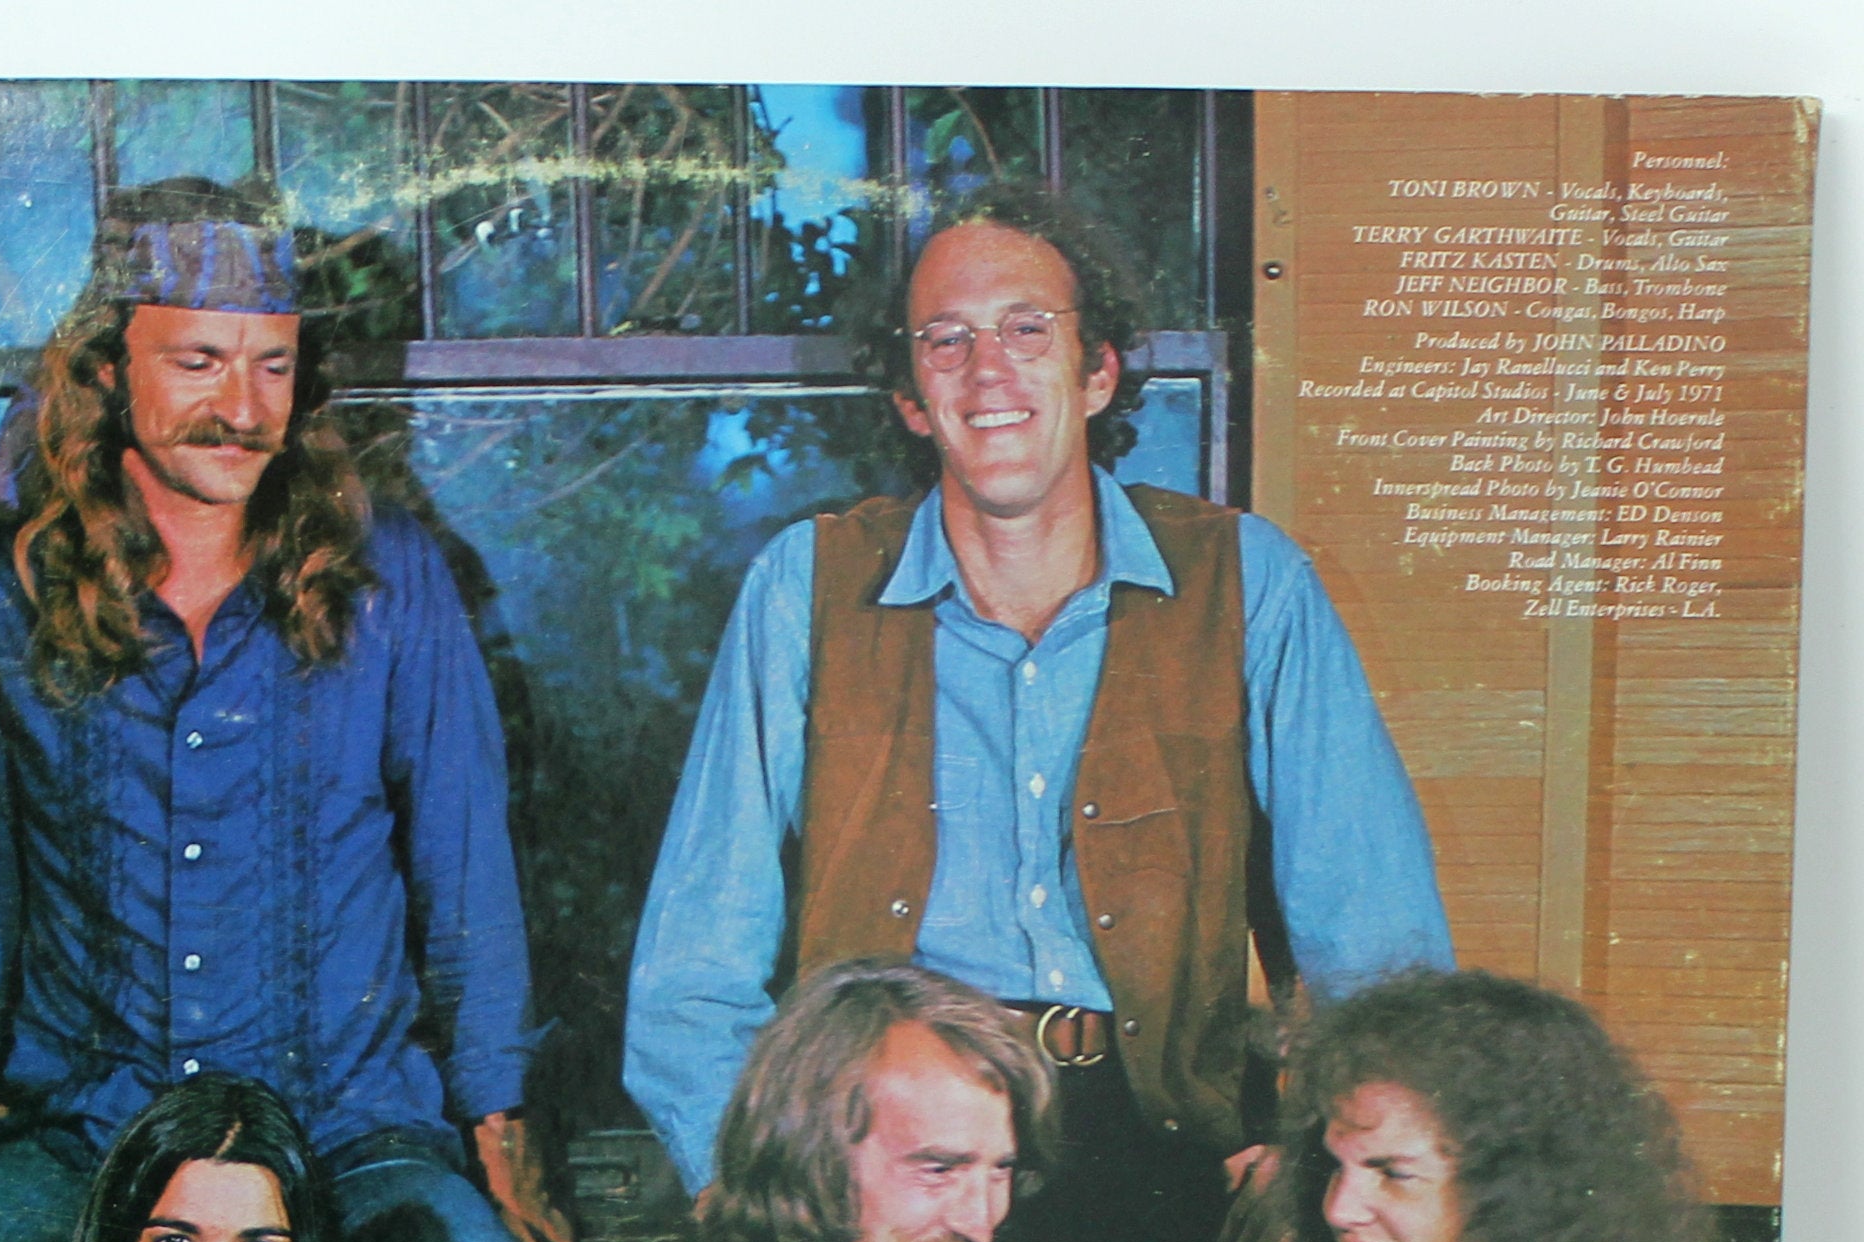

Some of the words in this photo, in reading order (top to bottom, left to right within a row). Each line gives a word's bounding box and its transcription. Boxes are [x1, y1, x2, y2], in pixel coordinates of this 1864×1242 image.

[1633, 151, 1729, 171] Personnel:
[1388, 180, 1447, 197] TONI
[1453, 181, 1542, 198] BROWN
[1562, 183, 1623, 203] Vocals,
[1628, 182, 1728, 205] Keyboards,
[1353, 226, 1426, 244] TERRY
[1434, 227, 1582, 246] GARTHWAITE
[1603, 230, 1662, 249] Vocals,
[1670, 231, 1728, 247] Guitar
[1396, 276, 1443, 295] JEFF
[1449, 277, 1567, 295] NEIGHBOR
[1585, 278, 1628, 297] Bass,
[1635, 279, 1728, 296] Trombone
[1364, 300, 1412, 318] RON
[1422, 301, 1507, 318] WILSON
[1526, 303, 1596, 324] Congas,
[1602, 303, 1674, 325] Bongos,
[1678, 304, 1725, 325] Harp
[1415, 332, 1499, 350] Produced
[1505, 332, 1526, 353] by
[1531, 334, 1592, 353] JOHN
[1601, 335, 1726, 353] PALLADINO
[1477, 408, 1507, 424] Art
[1514, 408, 1595, 426] Director:
[1599, 408, 1644, 428] John
[1649, 409, 1724, 427] Hoernle
[1406, 503, 1481, 521] Business
[1488, 504, 1611, 524] Management:
[1617, 505, 1646, 522] ED
[1652, 506, 1722, 523] Denson
[1508, 551, 1555, 569] Road
[1561, 552, 1646, 572] Manager:
[1652, 554, 1674, 570] Al
[1679, 554, 1722, 570] Finn
[1524, 600, 1563, 618] Zell
[1567, 601, 1665, 620] Enterprises
[1682, 601, 1721, 618] L.A.
